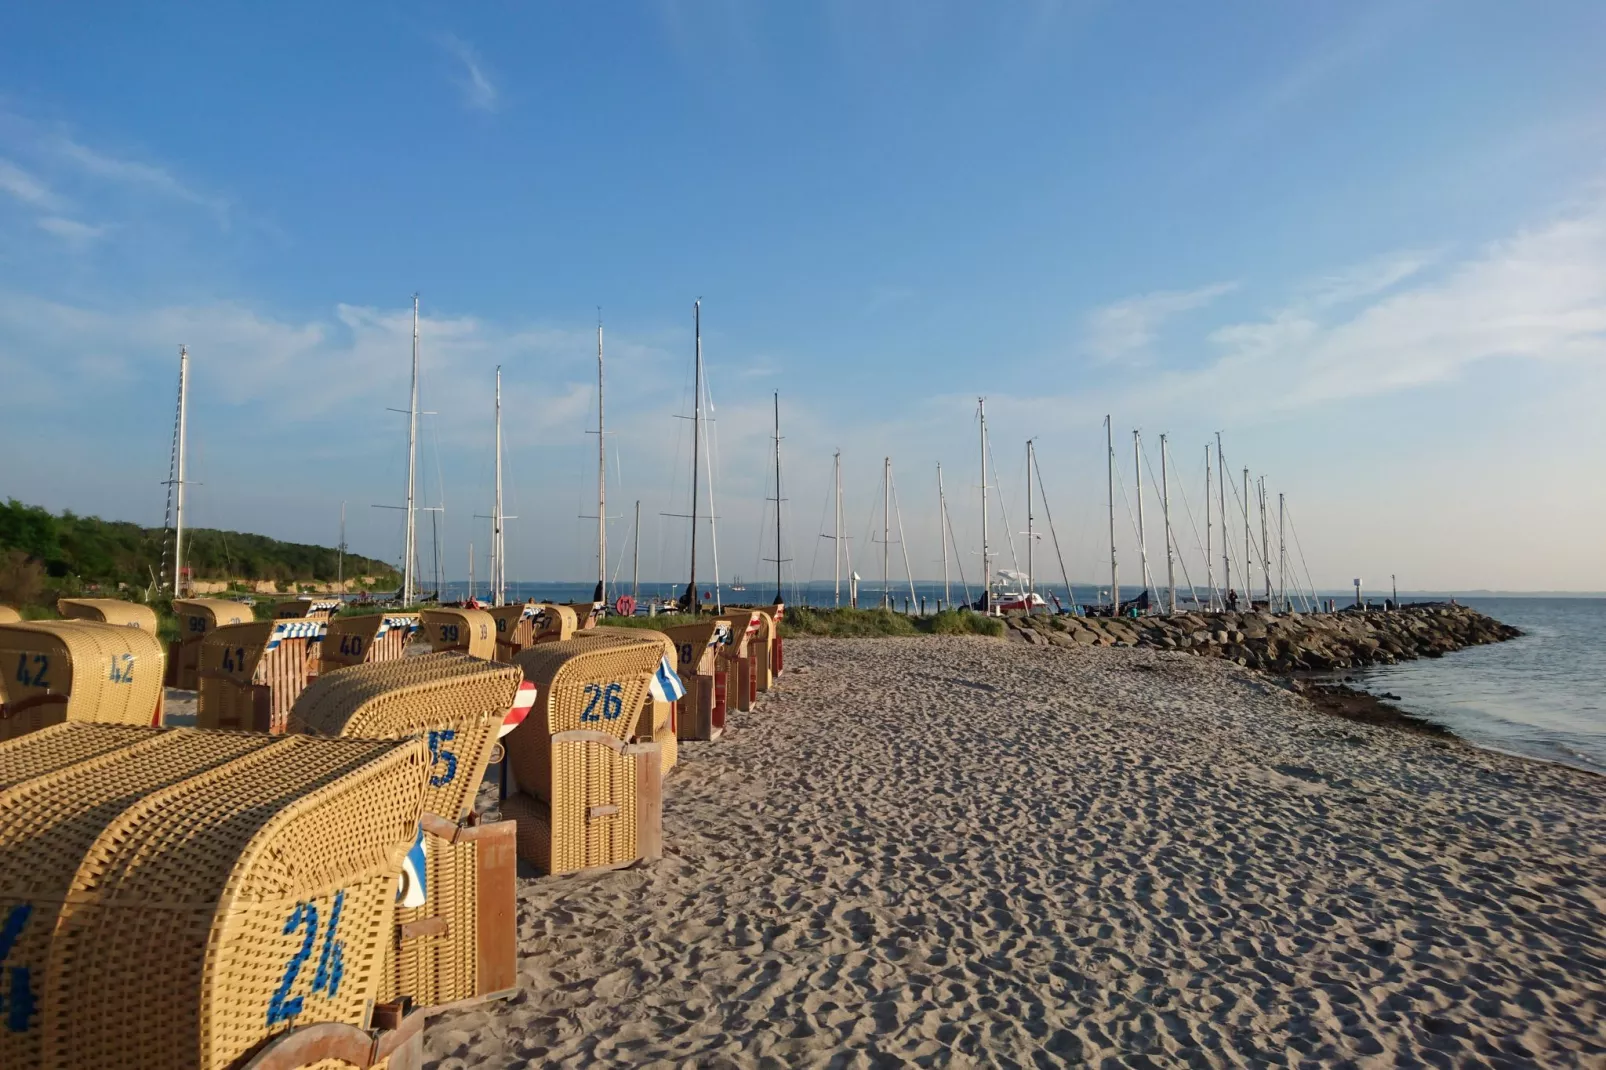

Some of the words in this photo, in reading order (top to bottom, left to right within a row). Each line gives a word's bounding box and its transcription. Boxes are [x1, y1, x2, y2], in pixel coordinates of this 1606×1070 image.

[189, 616, 206, 632] 99
[439, 624, 459, 643] 39
[339, 635, 362, 656] 40
[16, 653, 50, 687] 42
[109, 653, 134, 684] 42
[222, 647, 245, 673] 41
[580, 682, 623, 723] 26
